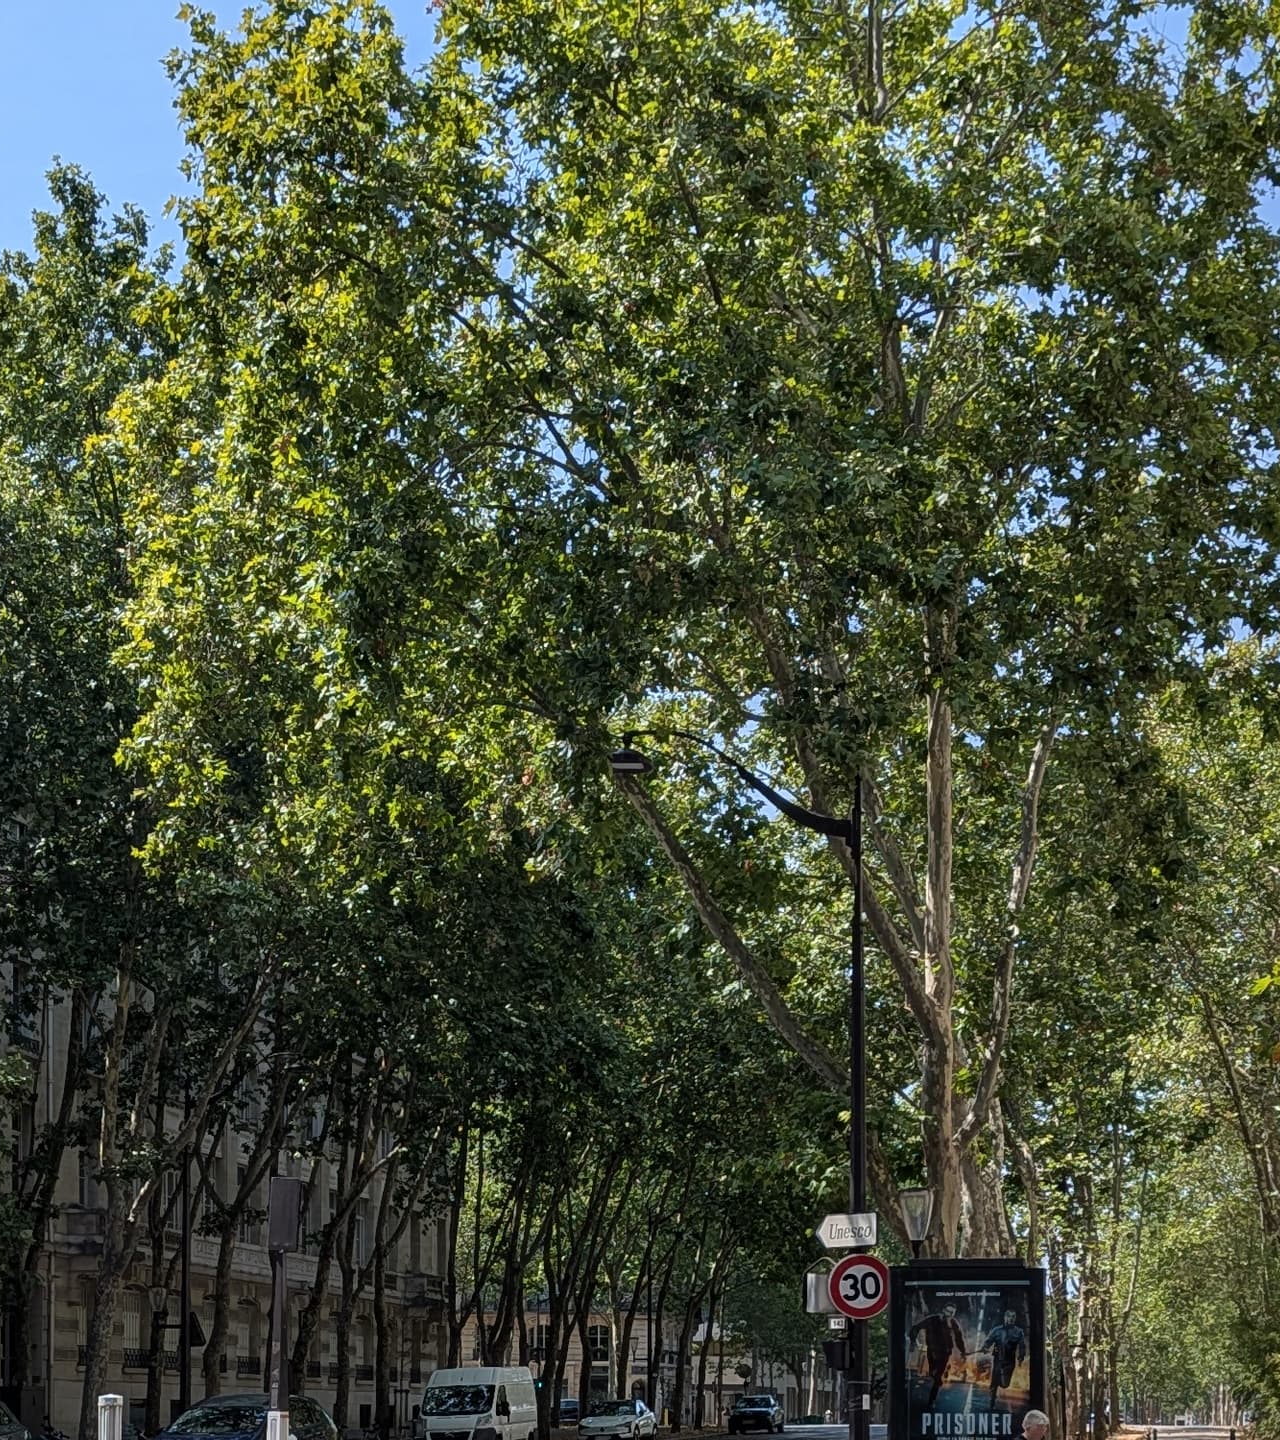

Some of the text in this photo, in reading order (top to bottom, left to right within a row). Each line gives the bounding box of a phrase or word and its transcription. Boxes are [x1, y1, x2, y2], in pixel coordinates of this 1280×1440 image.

[828, 1223, 873, 1240] Unesco
[842, 1271, 881, 1302] 30
[921, 1412, 1013, 1435] PRISONER
